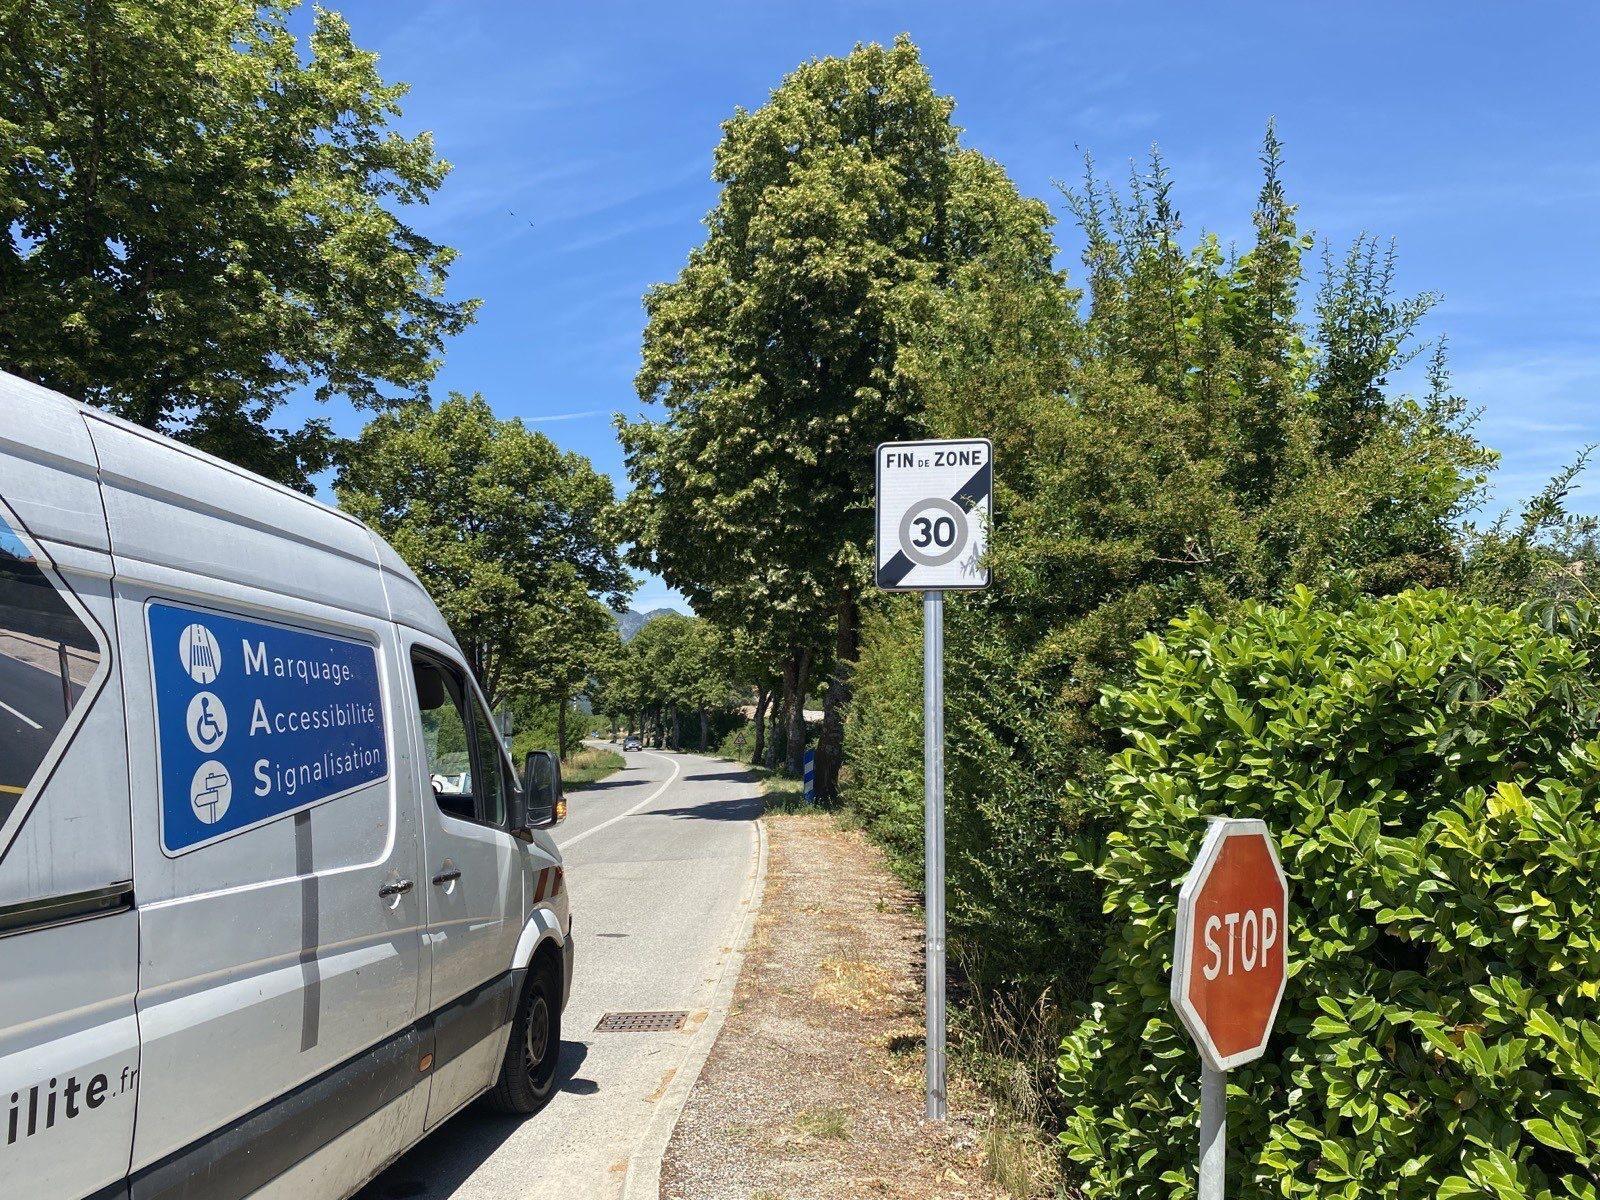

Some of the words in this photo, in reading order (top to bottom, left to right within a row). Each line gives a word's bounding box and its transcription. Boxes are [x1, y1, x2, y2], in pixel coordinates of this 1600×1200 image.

[886, 452, 914, 468] FIN
[918, 459, 930, 468] DE
[934, 450, 982, 467] ZONE
[912, 516, 955, 547] 30
[242, 639, 351, 685] Marquage
[250, 699, 375, 736] Accessibilité
[254, 747, 380, 797] Signalisation
[1203, 907, 1278, 982] STOP
